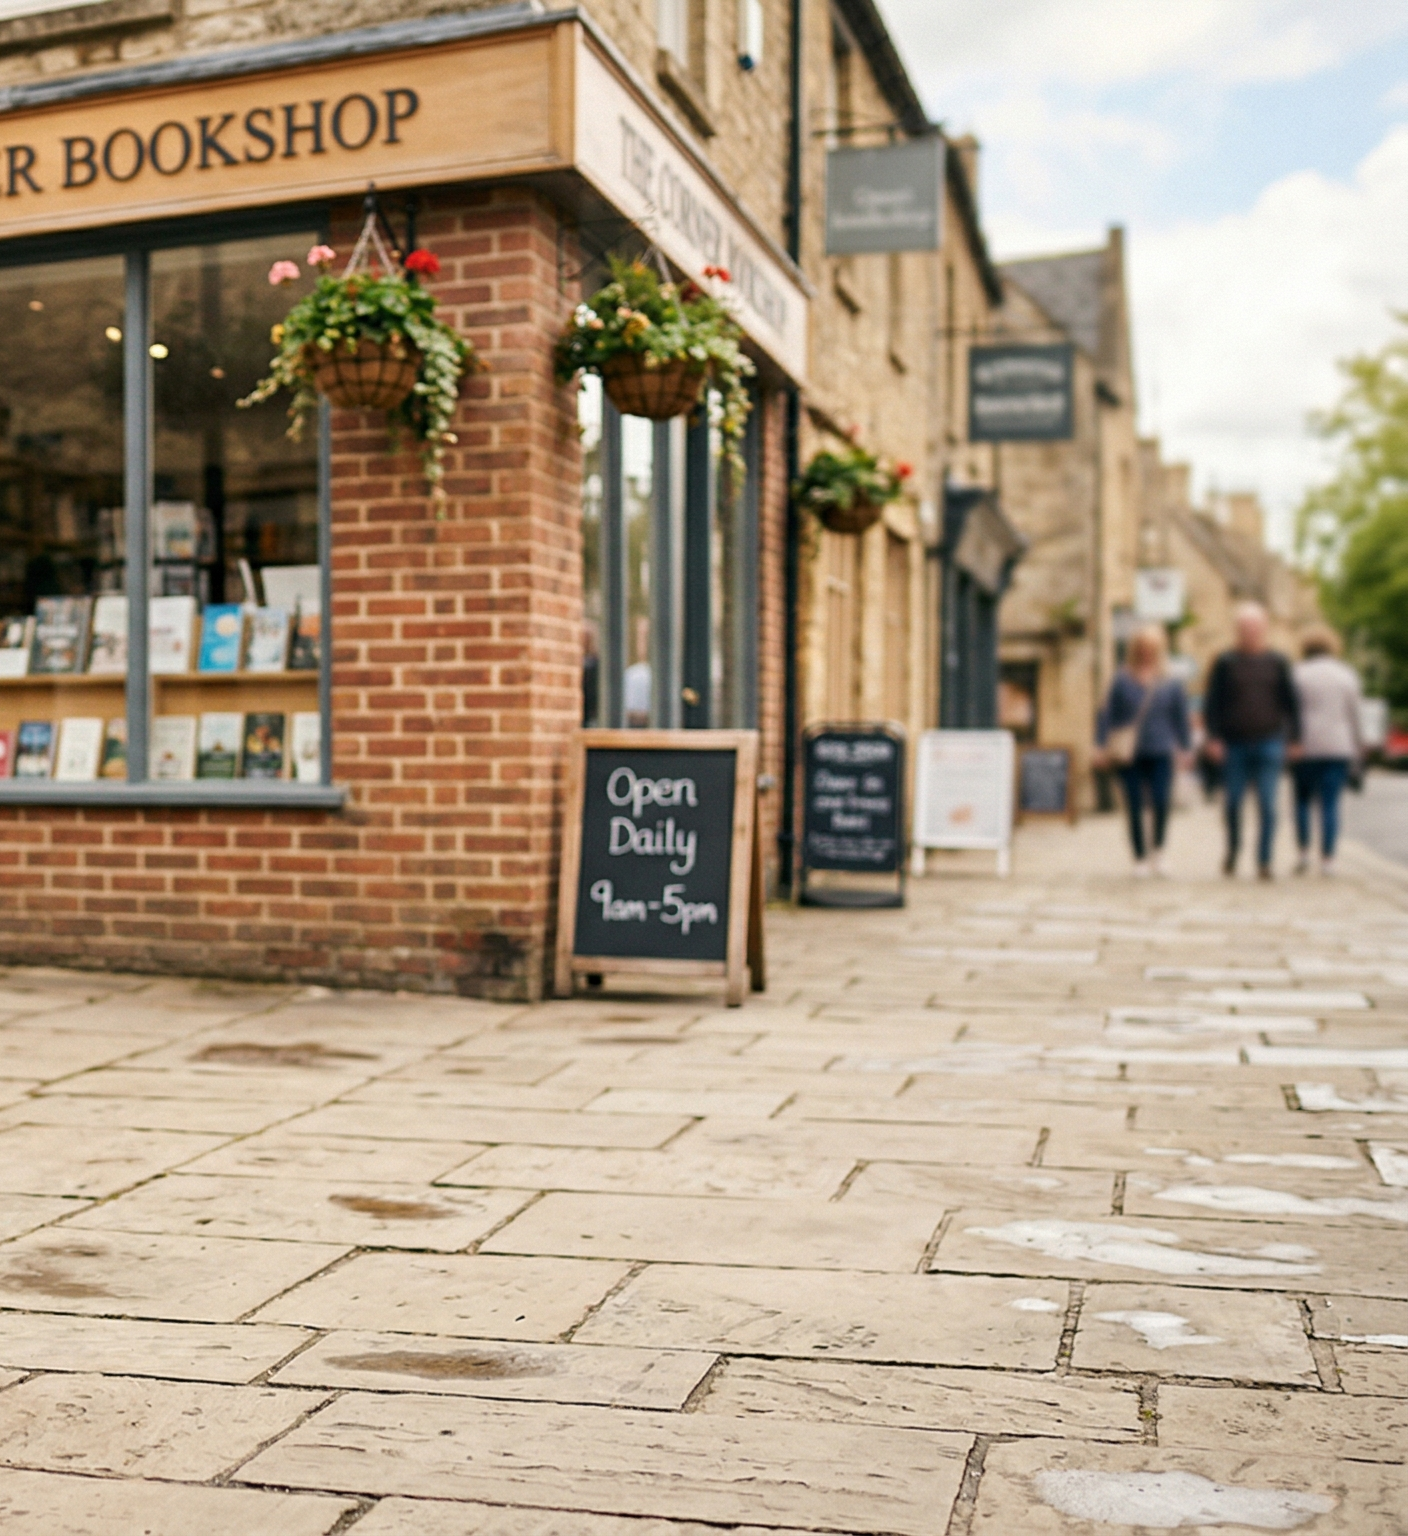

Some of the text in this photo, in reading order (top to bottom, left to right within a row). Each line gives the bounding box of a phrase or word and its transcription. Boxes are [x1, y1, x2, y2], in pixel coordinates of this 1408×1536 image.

[62, 88, 419, 189] BOOKSHOP
[606, 766, 698, 818] Open
[609, 816, 697, 876] Daily
[590, 879, 718, 935] 9am-5pm
